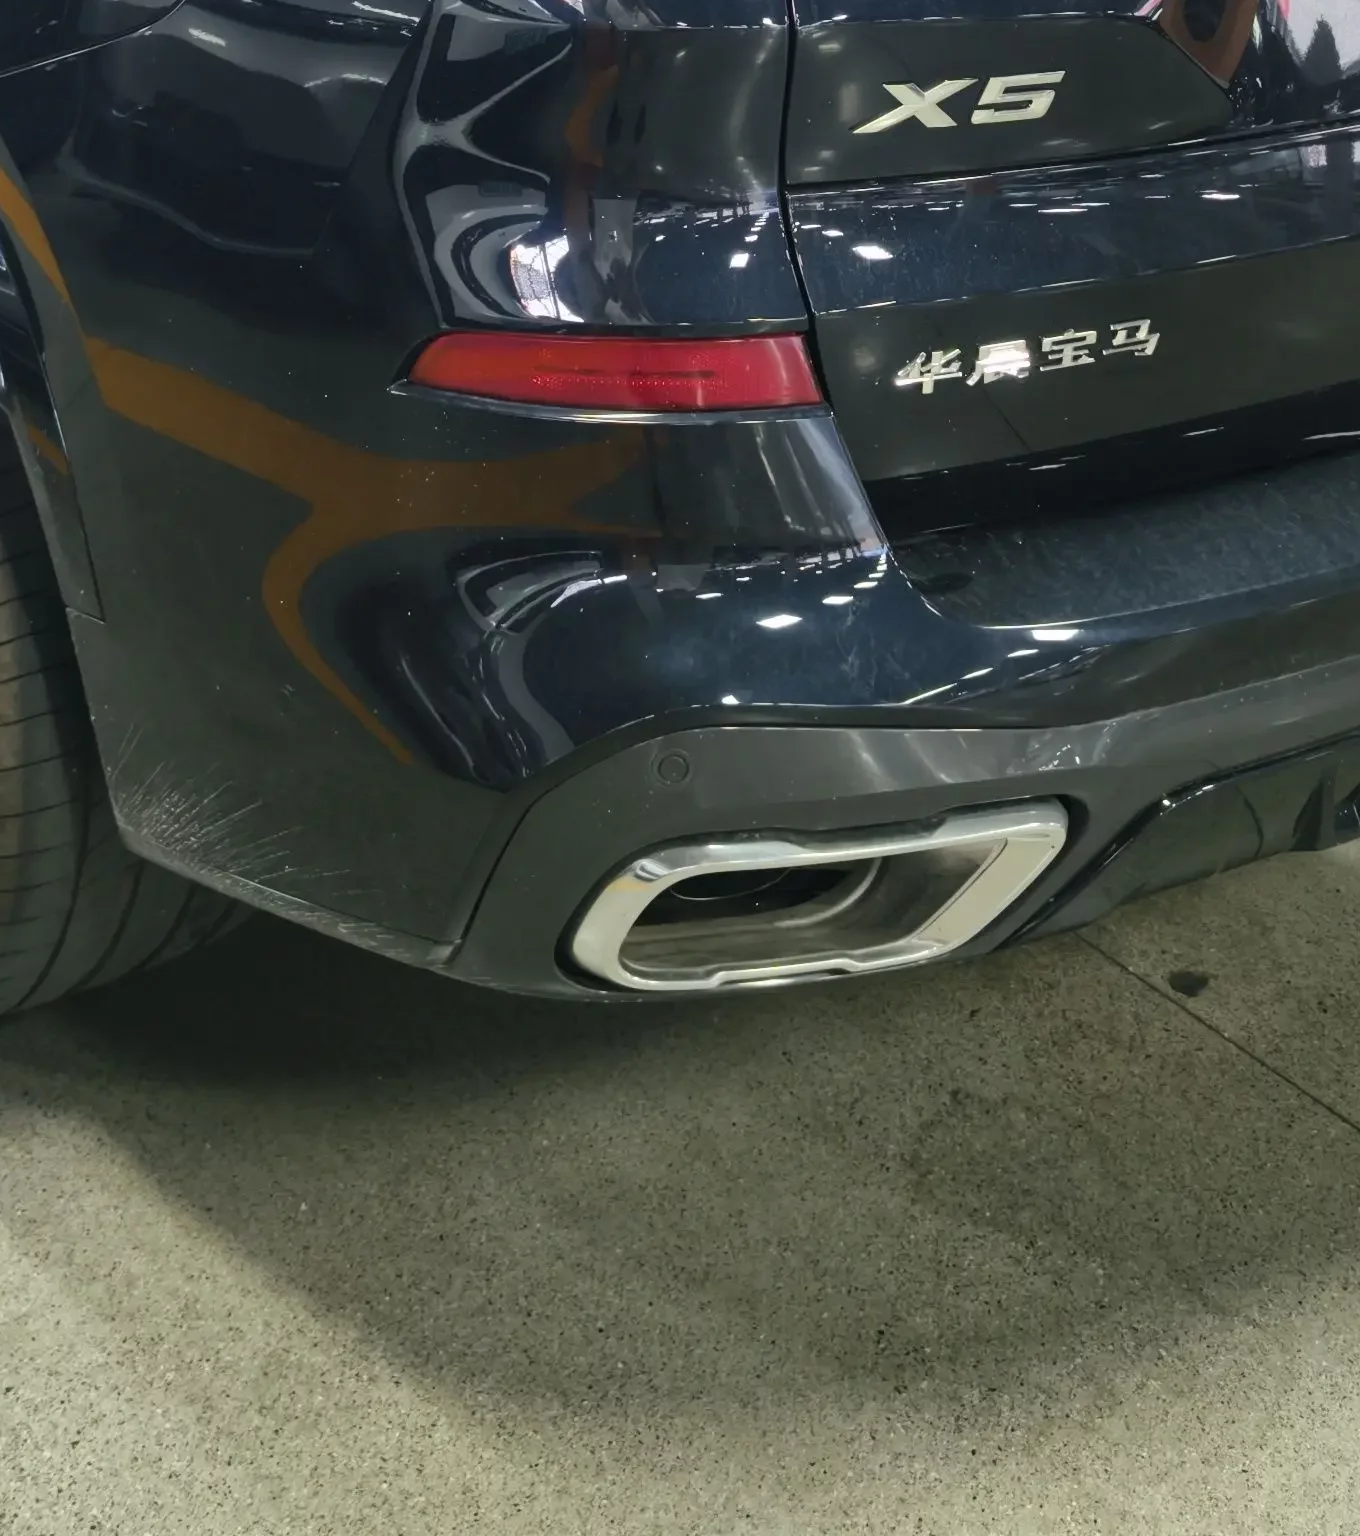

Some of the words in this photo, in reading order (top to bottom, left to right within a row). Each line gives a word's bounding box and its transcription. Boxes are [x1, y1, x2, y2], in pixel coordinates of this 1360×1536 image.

[851, 69, 1067, 134] X5
[895, 318, 1161, 395] 华晨宝马
